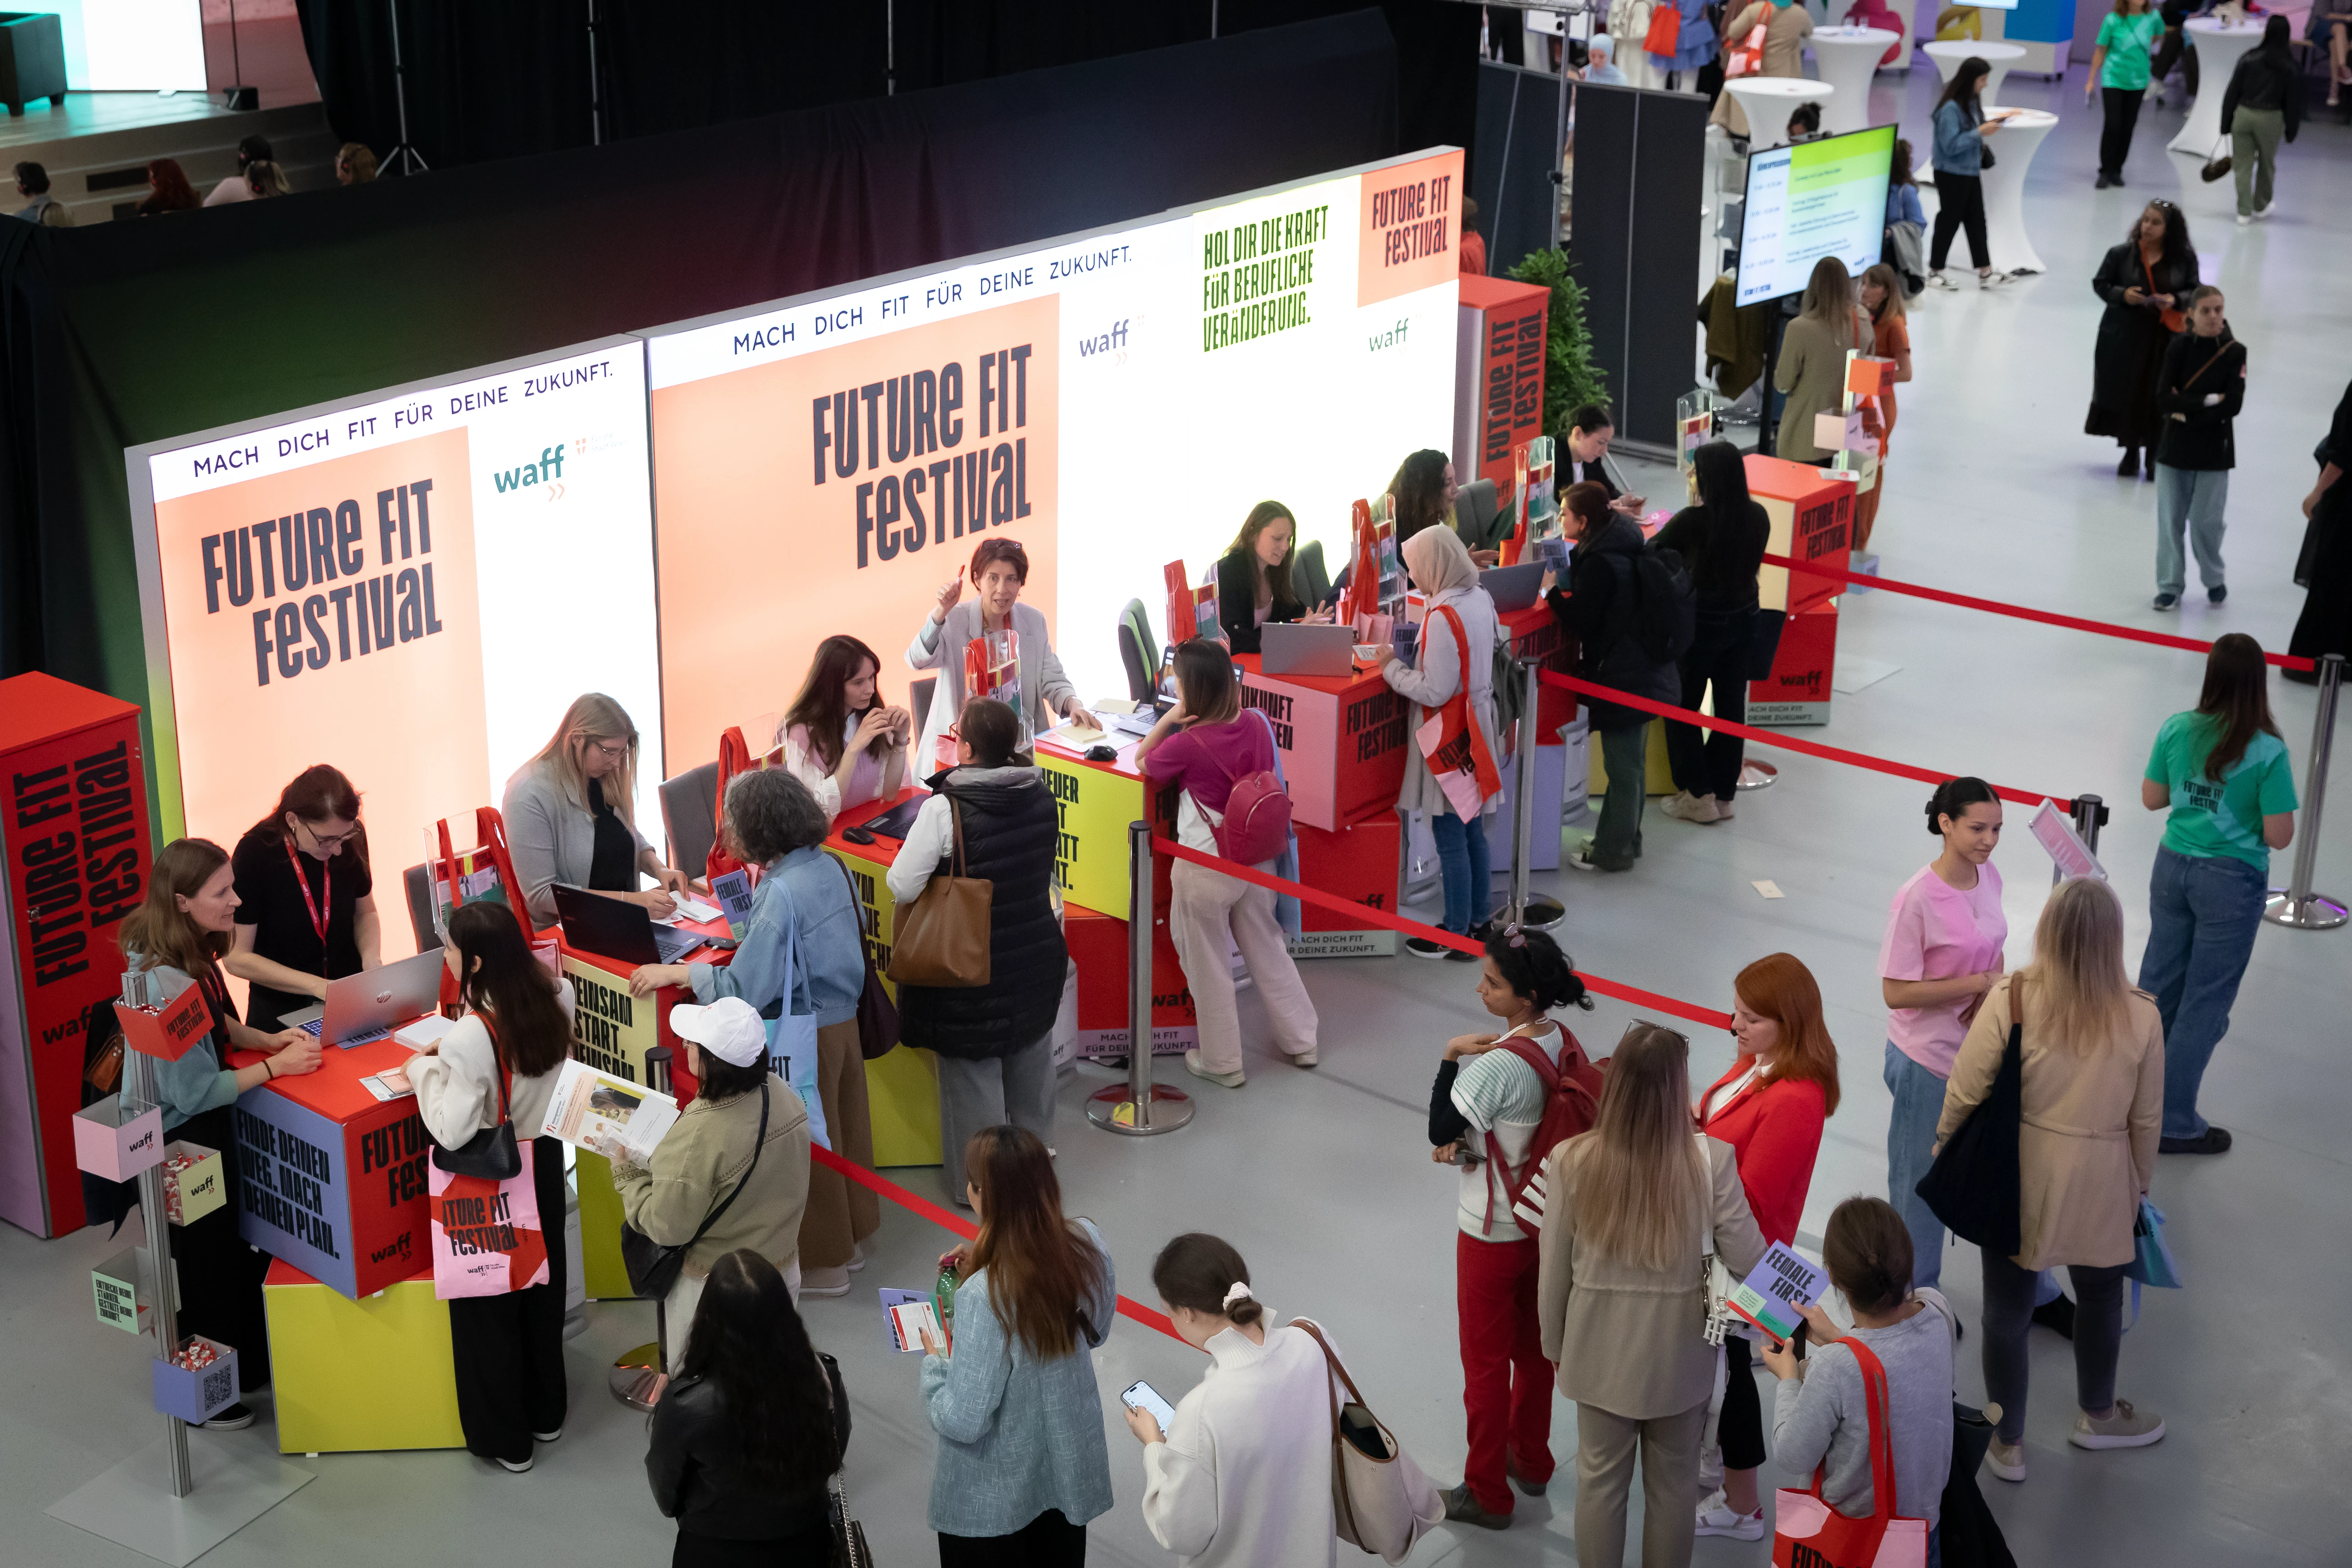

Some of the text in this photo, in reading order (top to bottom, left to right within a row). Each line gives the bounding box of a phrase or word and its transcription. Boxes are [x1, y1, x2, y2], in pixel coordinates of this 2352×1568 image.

[1430, 175, 1451, 215] FIT
[1204, 205, 1328, 270] HOL DIR DIE KRAFT
[1233, 249, 1313, 304] BERUFLICHE
[733, 245, 1131, 355] MACH DICH FIT FÜR DEINE ZUKUNFT.
[1079, 319, 1130, 358] waff
[1203, 291, 1311, 353] VERÄNDERUNG.
[1369, 317, 1409, 352] waff
[1491, 320, 1515, 358] FIT
[979, 343, 1032, 439] FIT
[193, 361, 614, 477] MACH DICH FIT FÜR DEINE ZUKUNFT.
[494, 444, 565, 494] waff
[376, 477, 433, 565] FIT
[1780, 671, 1822, 686] waff
[1241, 684, 1294, 722] UKUNFT
[1358, 714, 1408, 764] FeSTIV
[13, 764, 73, 830] FIT
[1056, 831, 1079, 863] ATT
[716, 878, 744, 901] FEMALE
[731, 893, 753, 914] FIRST
[1298, 946, 1327, 955] DEINE
[1322, 935, 1347, 944] DICH
[1348, 935, 1364, 943] FIT
[1152, 987, 1195, 1007] waf
[42, 1006, 92, 1045] waf
[574, 1008, 626, 1060] START,
[1163, 1031, 1179, 1039] FIT
[573, 1042, 635, 1083] EINSAM
[1054, 1043, 1065, 1057] aff
[1086, 1043, 1105, 1053] FÜR
[771, 1056, 791, 1082] FIT
[129, 1130, 153, 1153] waff
[236, 1106, 277, 1158] FINDE
[277, 1127, 331, 1185] DEINEN
[190, 1175, 214, 1197] waff
[239, 1145, 323, 1216] WEG. MACH
[243, 1181, 340, 1260] DEINEN PLAN.
[442, 1191, 511, 1227] TURe FIT
[371, 1231, 412, 1264] waff
[467, 1265, 484, 1273] waff
[1765, 1248, 1816, 1291] FEMALE
[98, 1298, 120, 1313] GESTALTE
[1770, 1276, 1811, 1306] FIRST
